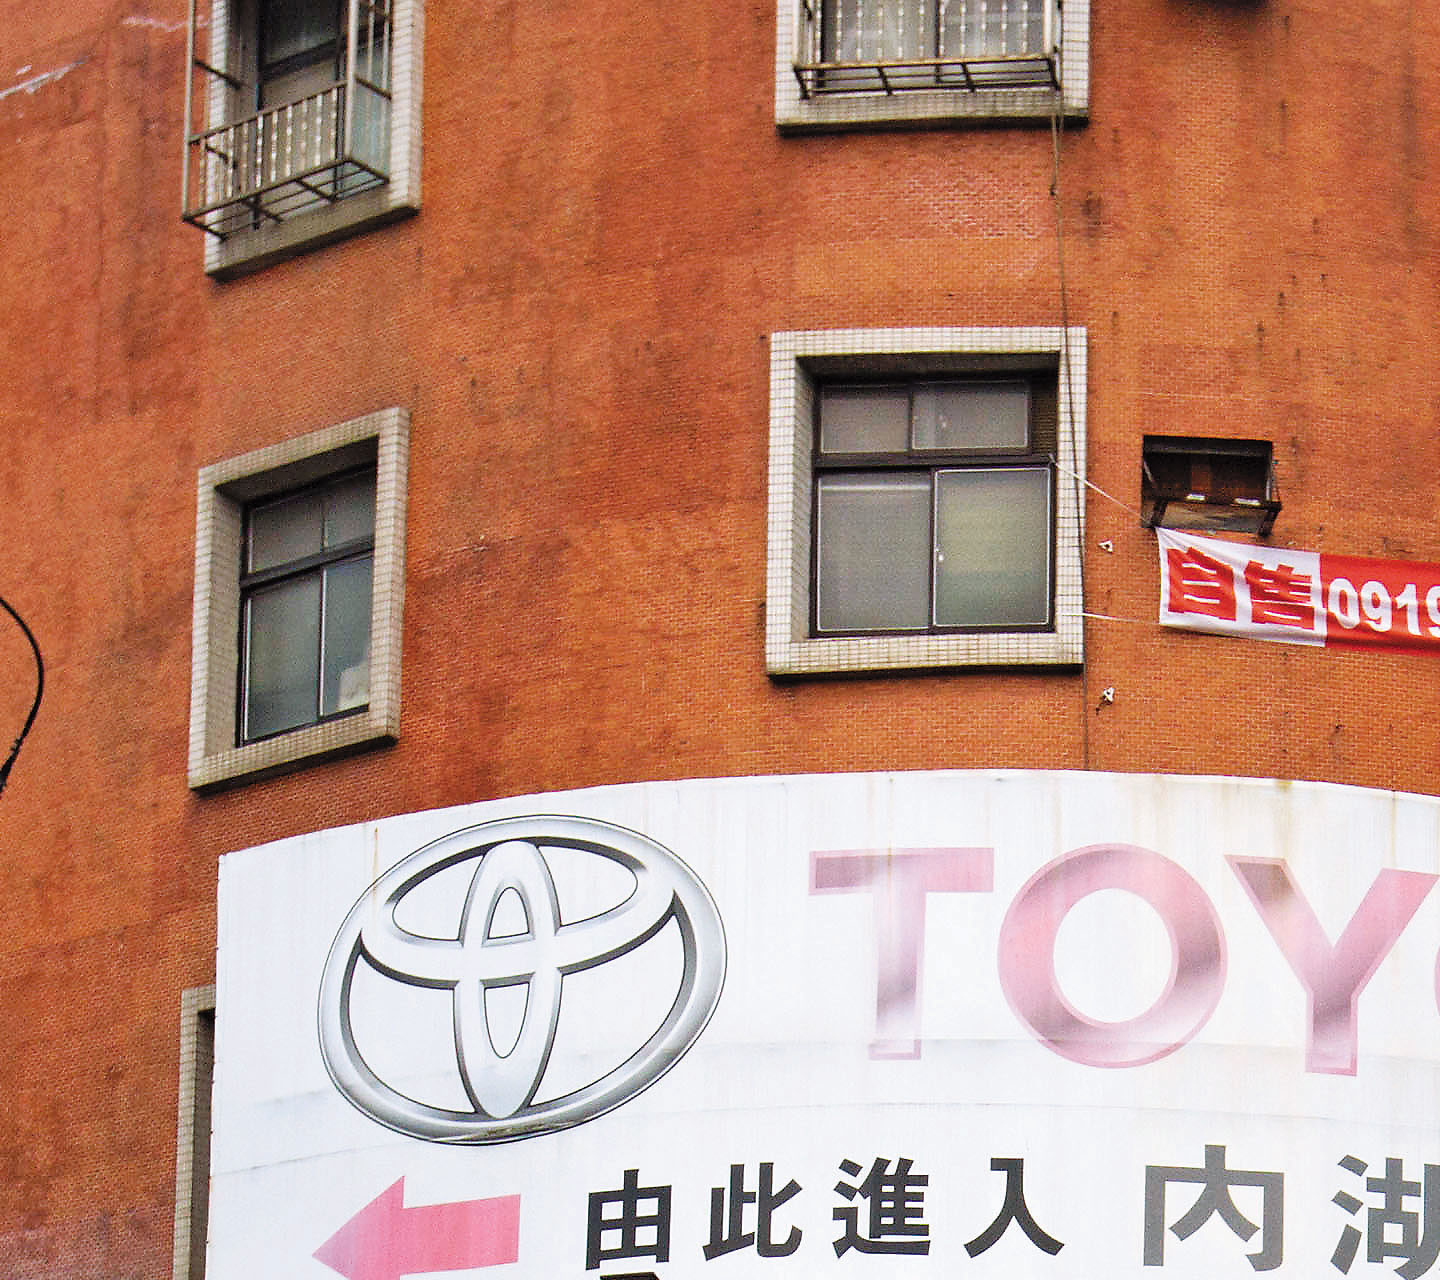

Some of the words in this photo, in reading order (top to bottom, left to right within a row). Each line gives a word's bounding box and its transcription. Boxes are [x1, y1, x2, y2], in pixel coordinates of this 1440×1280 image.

[1167, 546, 1315, 630] 自售
[583, 1157, 1065, 1272] 由此進入
